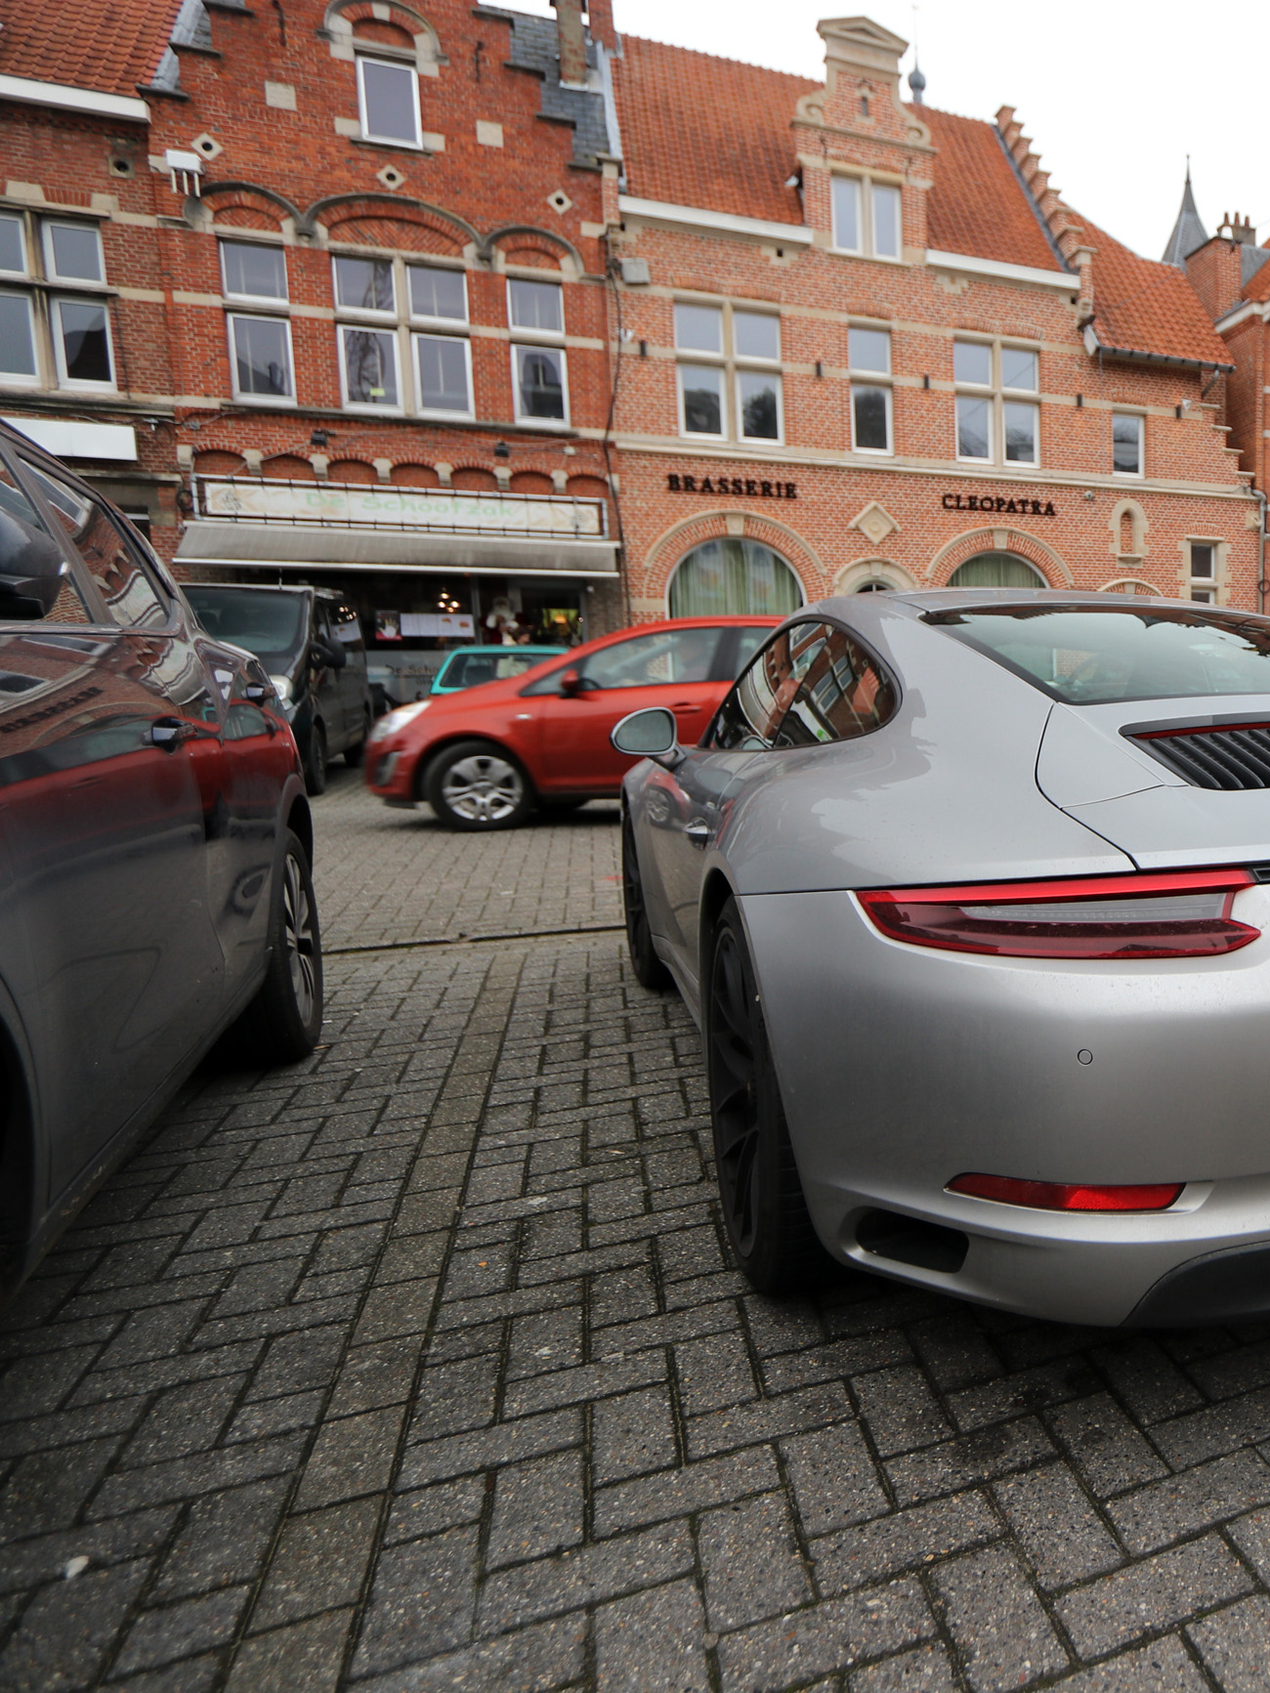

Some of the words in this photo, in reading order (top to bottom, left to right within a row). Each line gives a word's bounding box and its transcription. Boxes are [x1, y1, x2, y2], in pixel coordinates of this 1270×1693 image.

[667, 473, 798, 499] BRASSERIE
[305, 493, 346, 509] De
[361, 494, 514, 517] Schoofzak
[942, 494, 1057, 516] CLEOPATRA
